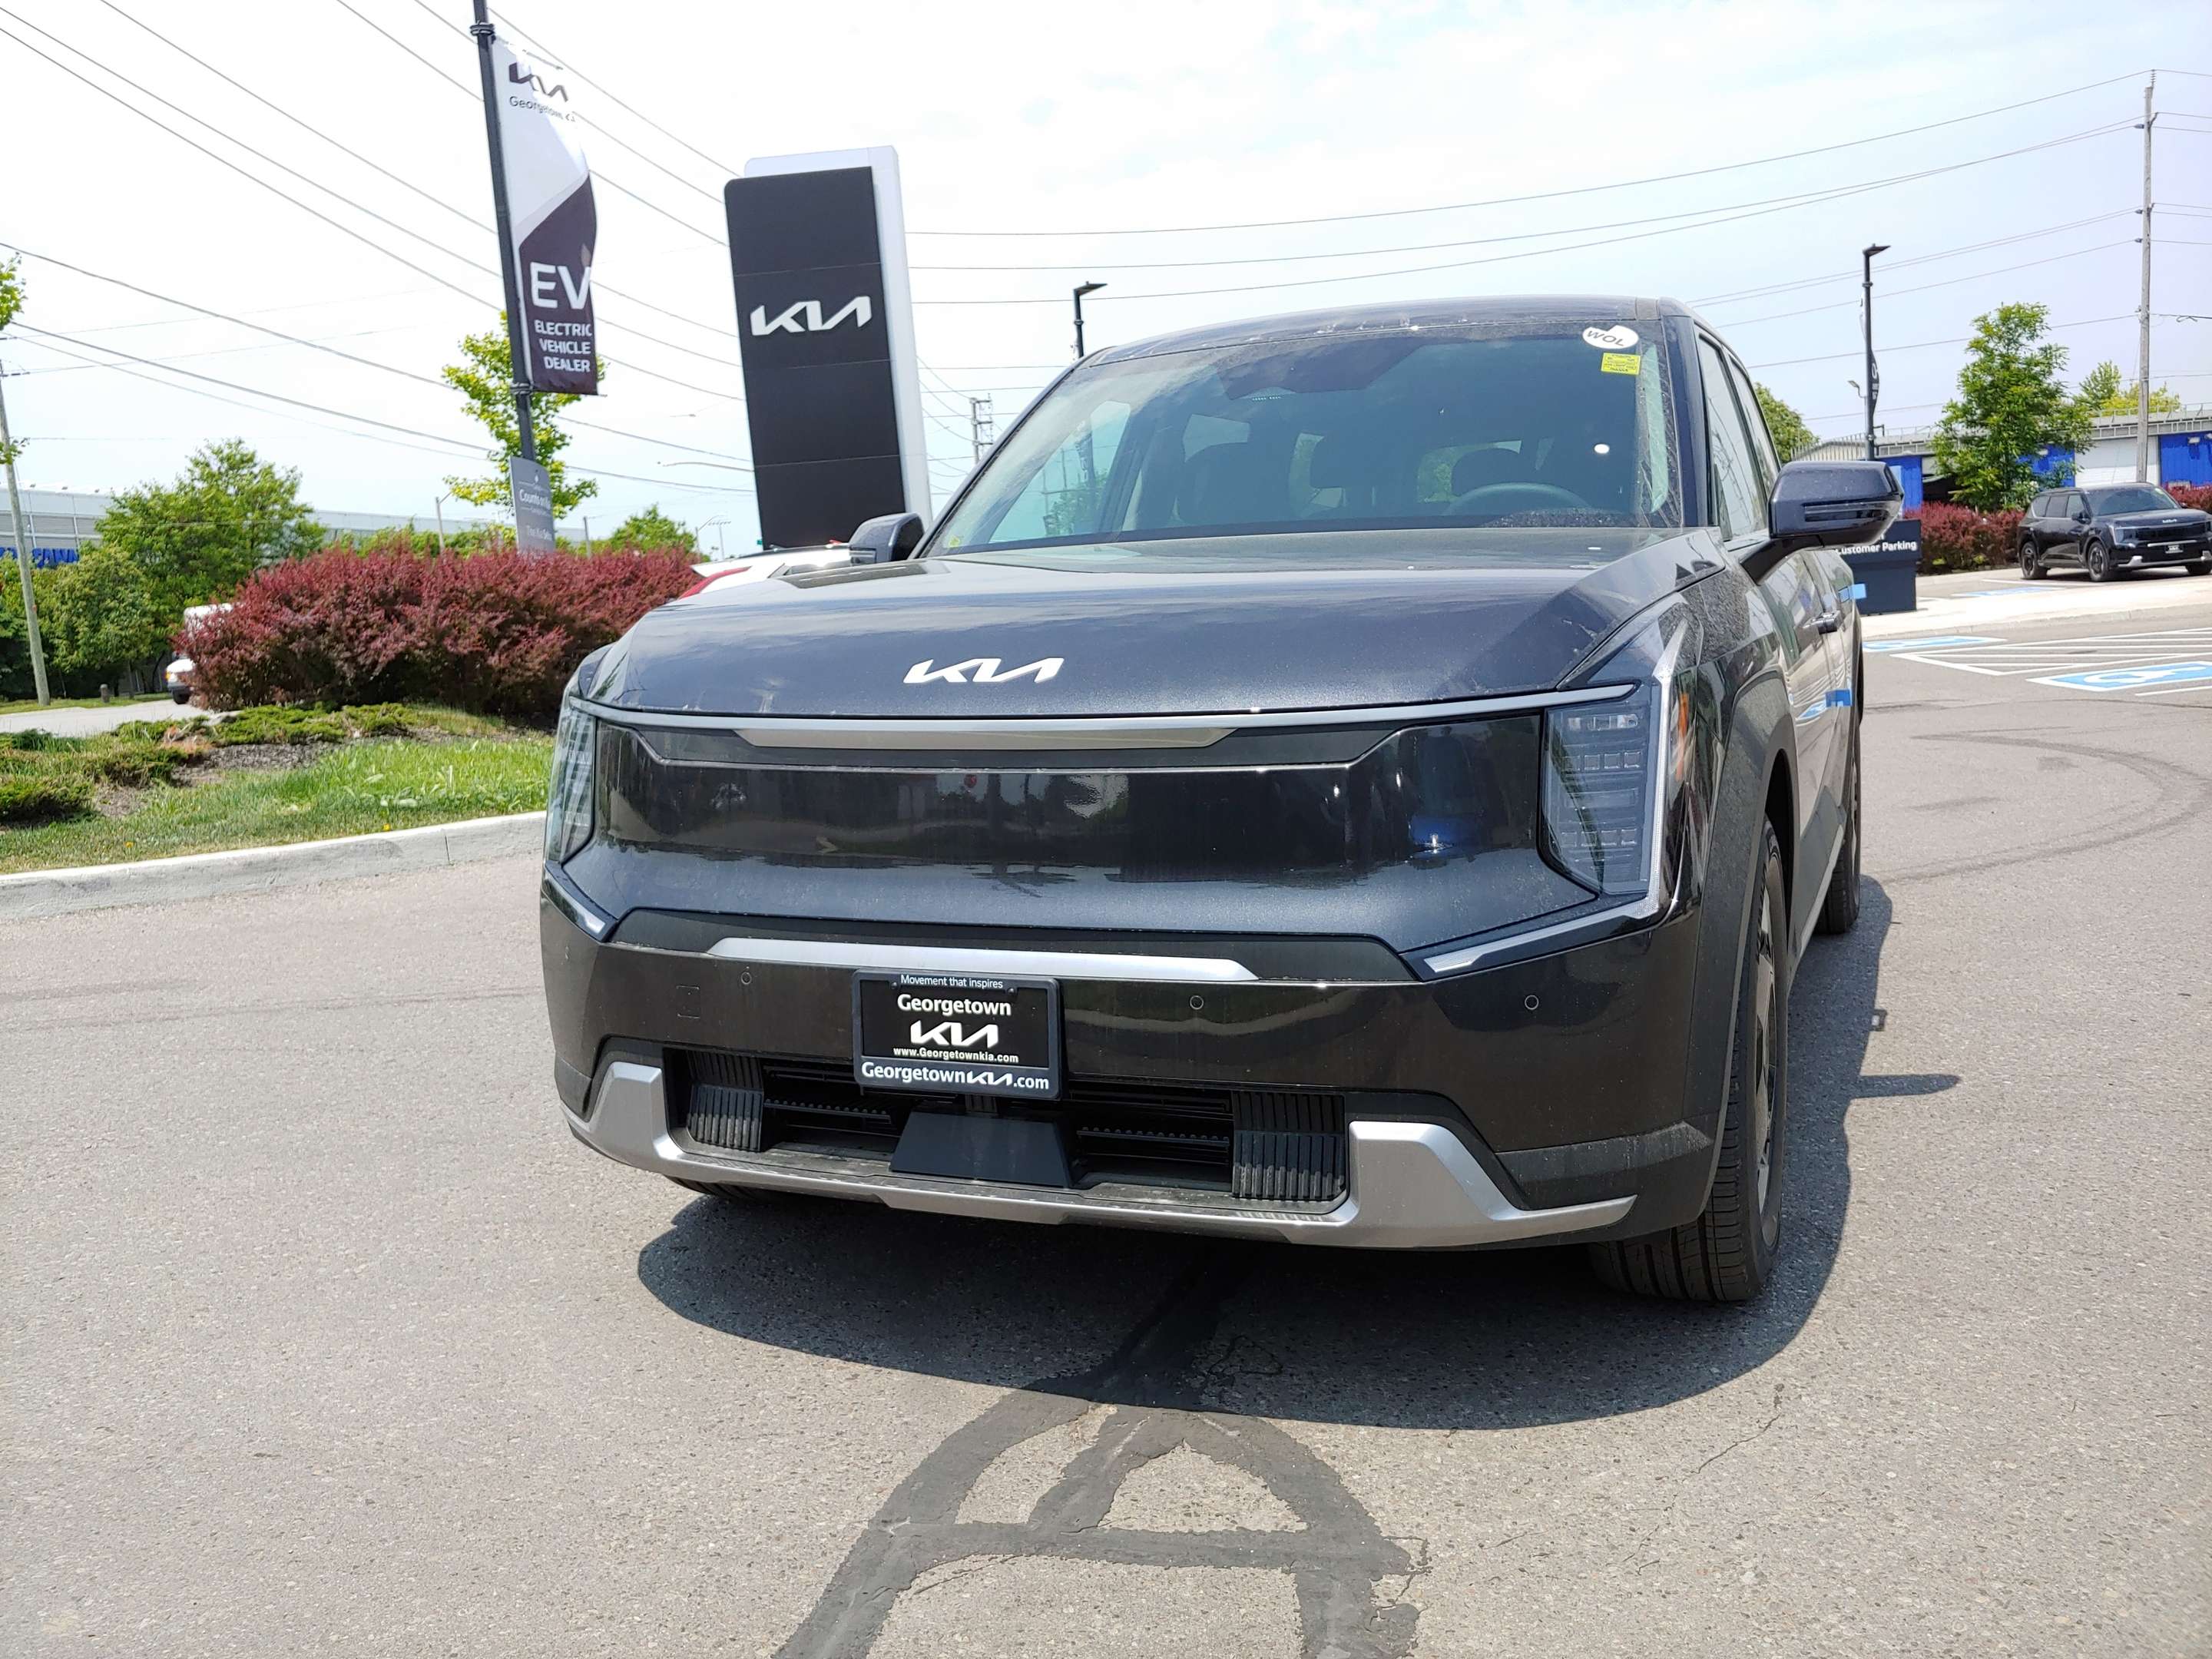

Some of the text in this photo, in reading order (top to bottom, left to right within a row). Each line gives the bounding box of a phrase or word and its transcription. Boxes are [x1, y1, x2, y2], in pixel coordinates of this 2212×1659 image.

[530, 262, 591, 310] EV
[750, 296, 873, 336] KIA
[534, 320, 592, 336] ELECTRIC
[539, 338, 591, 355] VEHICLE
[544, 356, 591, 373] DEALER
[1883, 539, 1918, 552] Parking
[902, 657, 1065, 684] KIA
[901, 975, 1003, 989] Movement that inspires
[897, 993, 1012, 1017] Georgetown
[910, 1020, 998, 1049] KIA
[893, 1047, 1019, 1064] www.Georgetownkia.com
